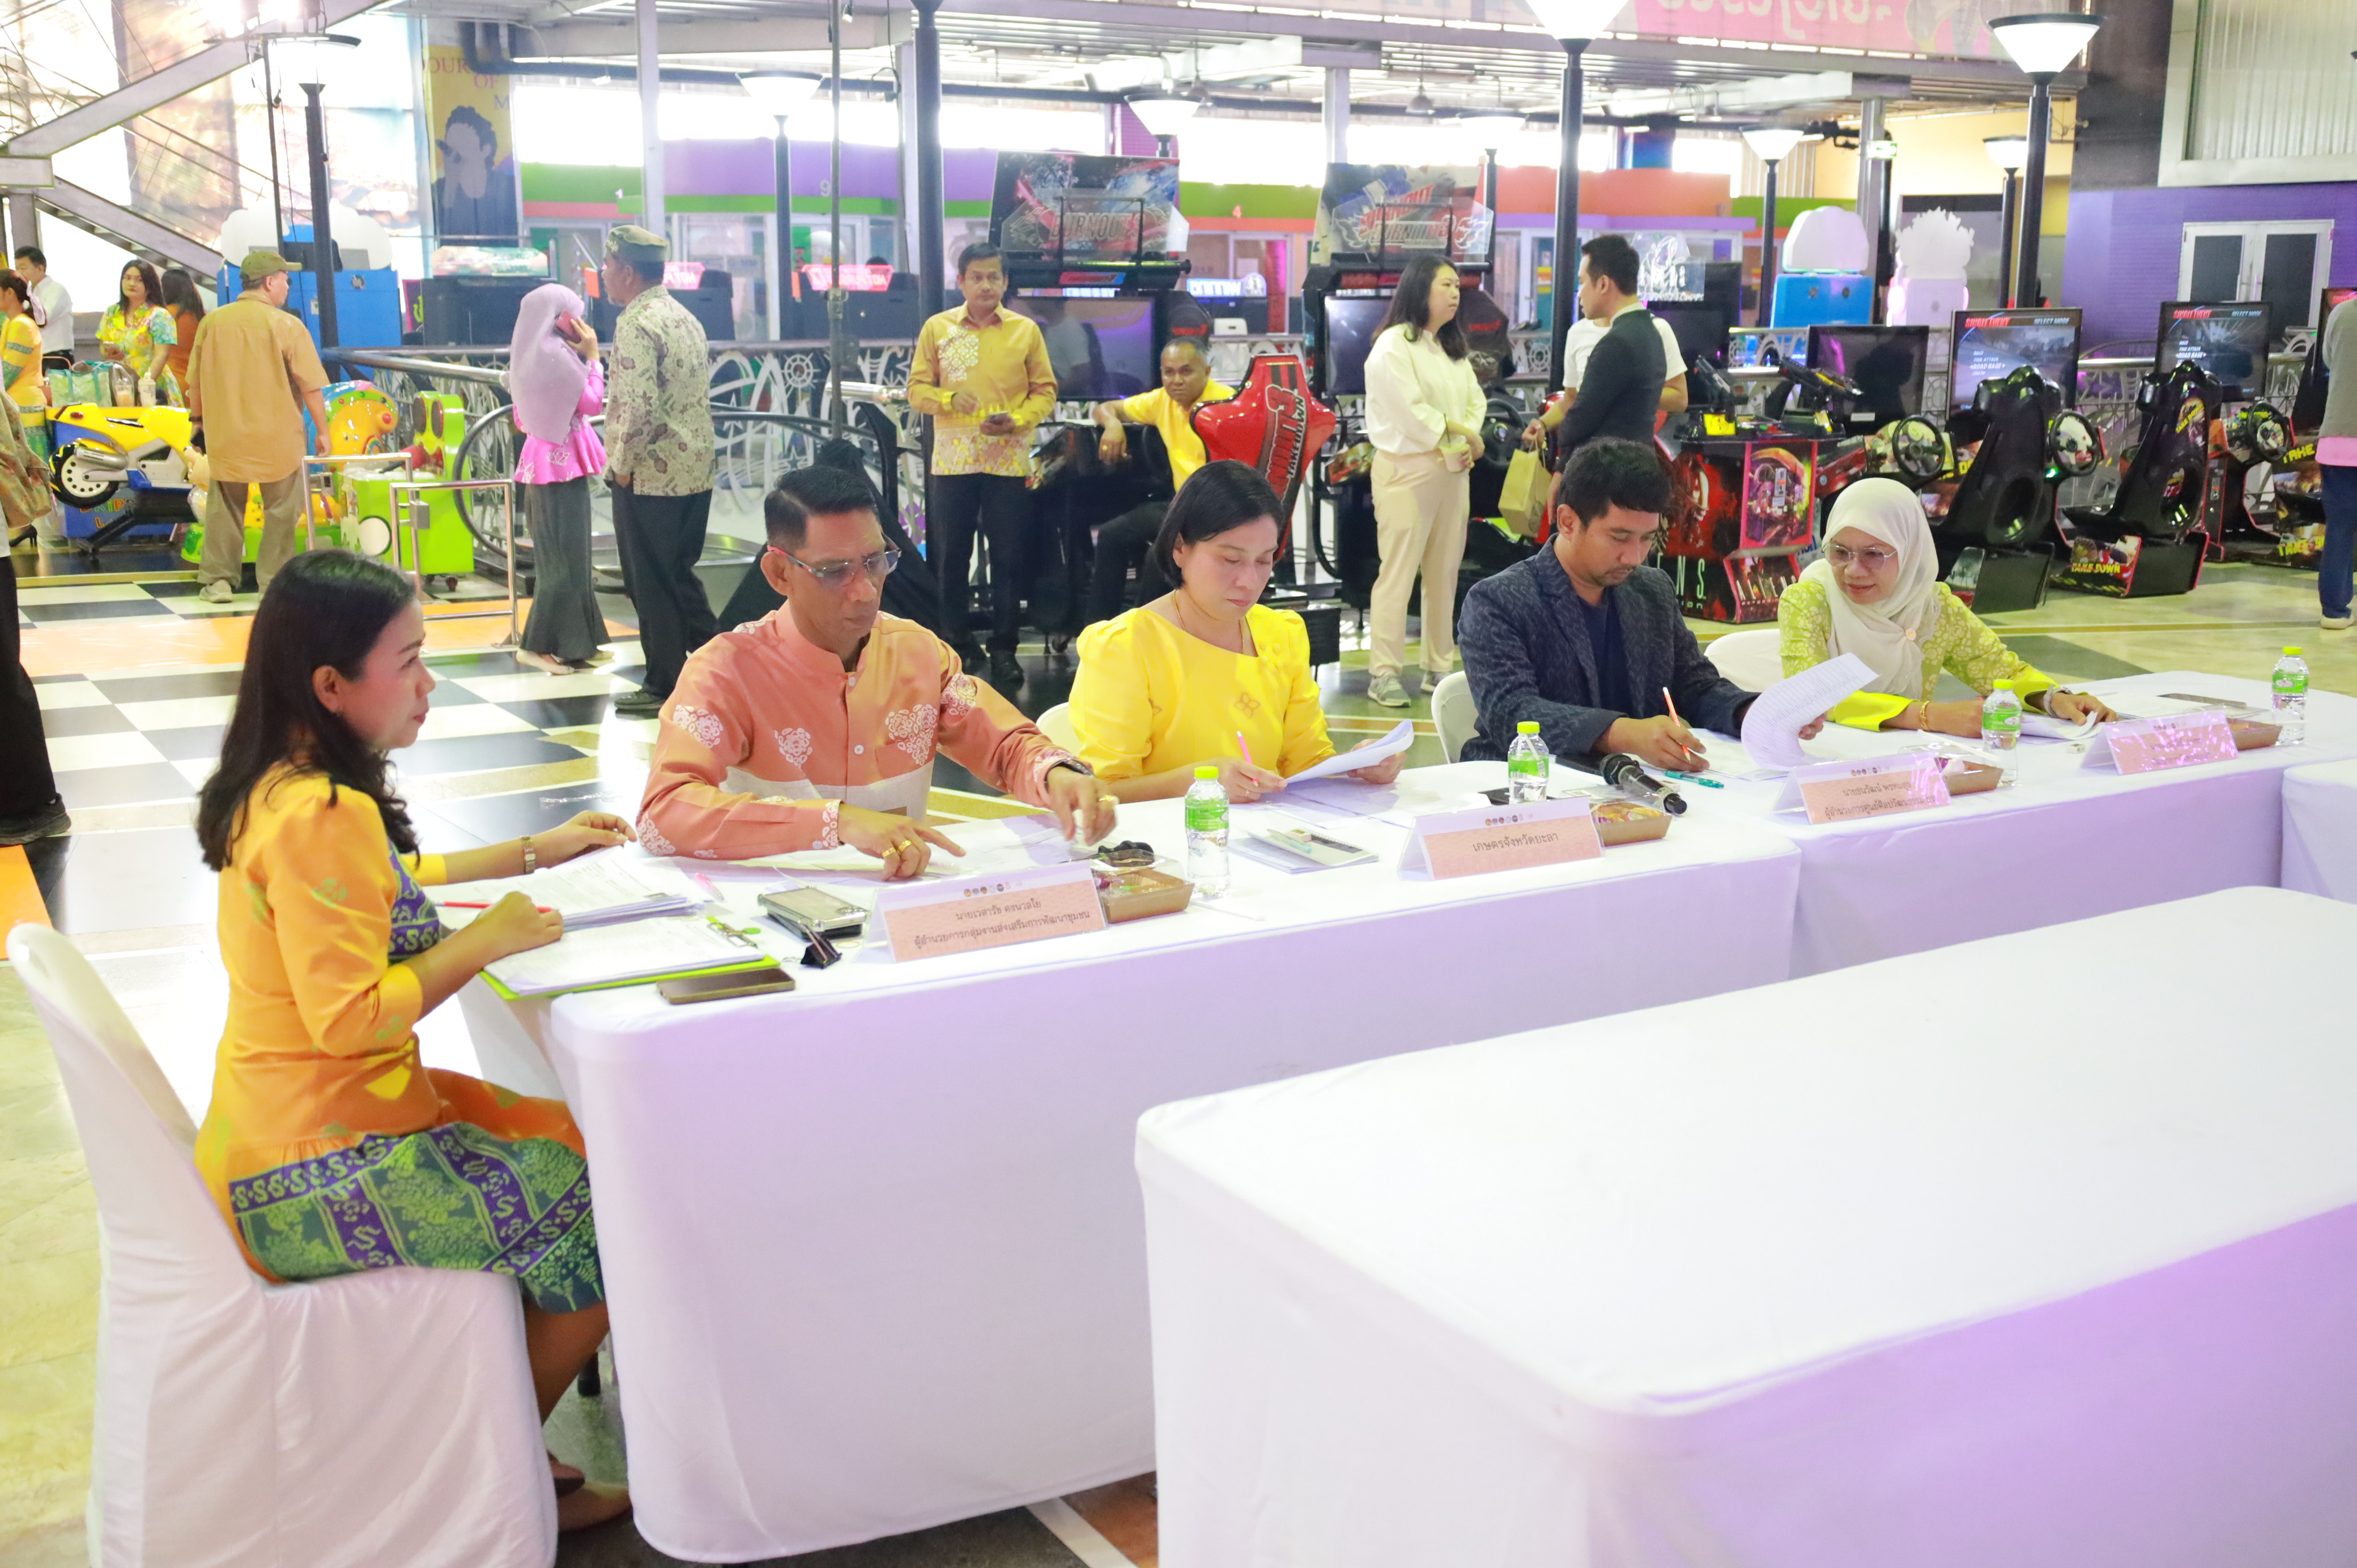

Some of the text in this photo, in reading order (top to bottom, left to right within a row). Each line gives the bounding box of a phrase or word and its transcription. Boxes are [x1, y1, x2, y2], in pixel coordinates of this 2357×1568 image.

[2071, 563, 2121, 574] TAKE DOWN
[1473, 832, 1559, 852] เกษตรจังหวัดยะลา
